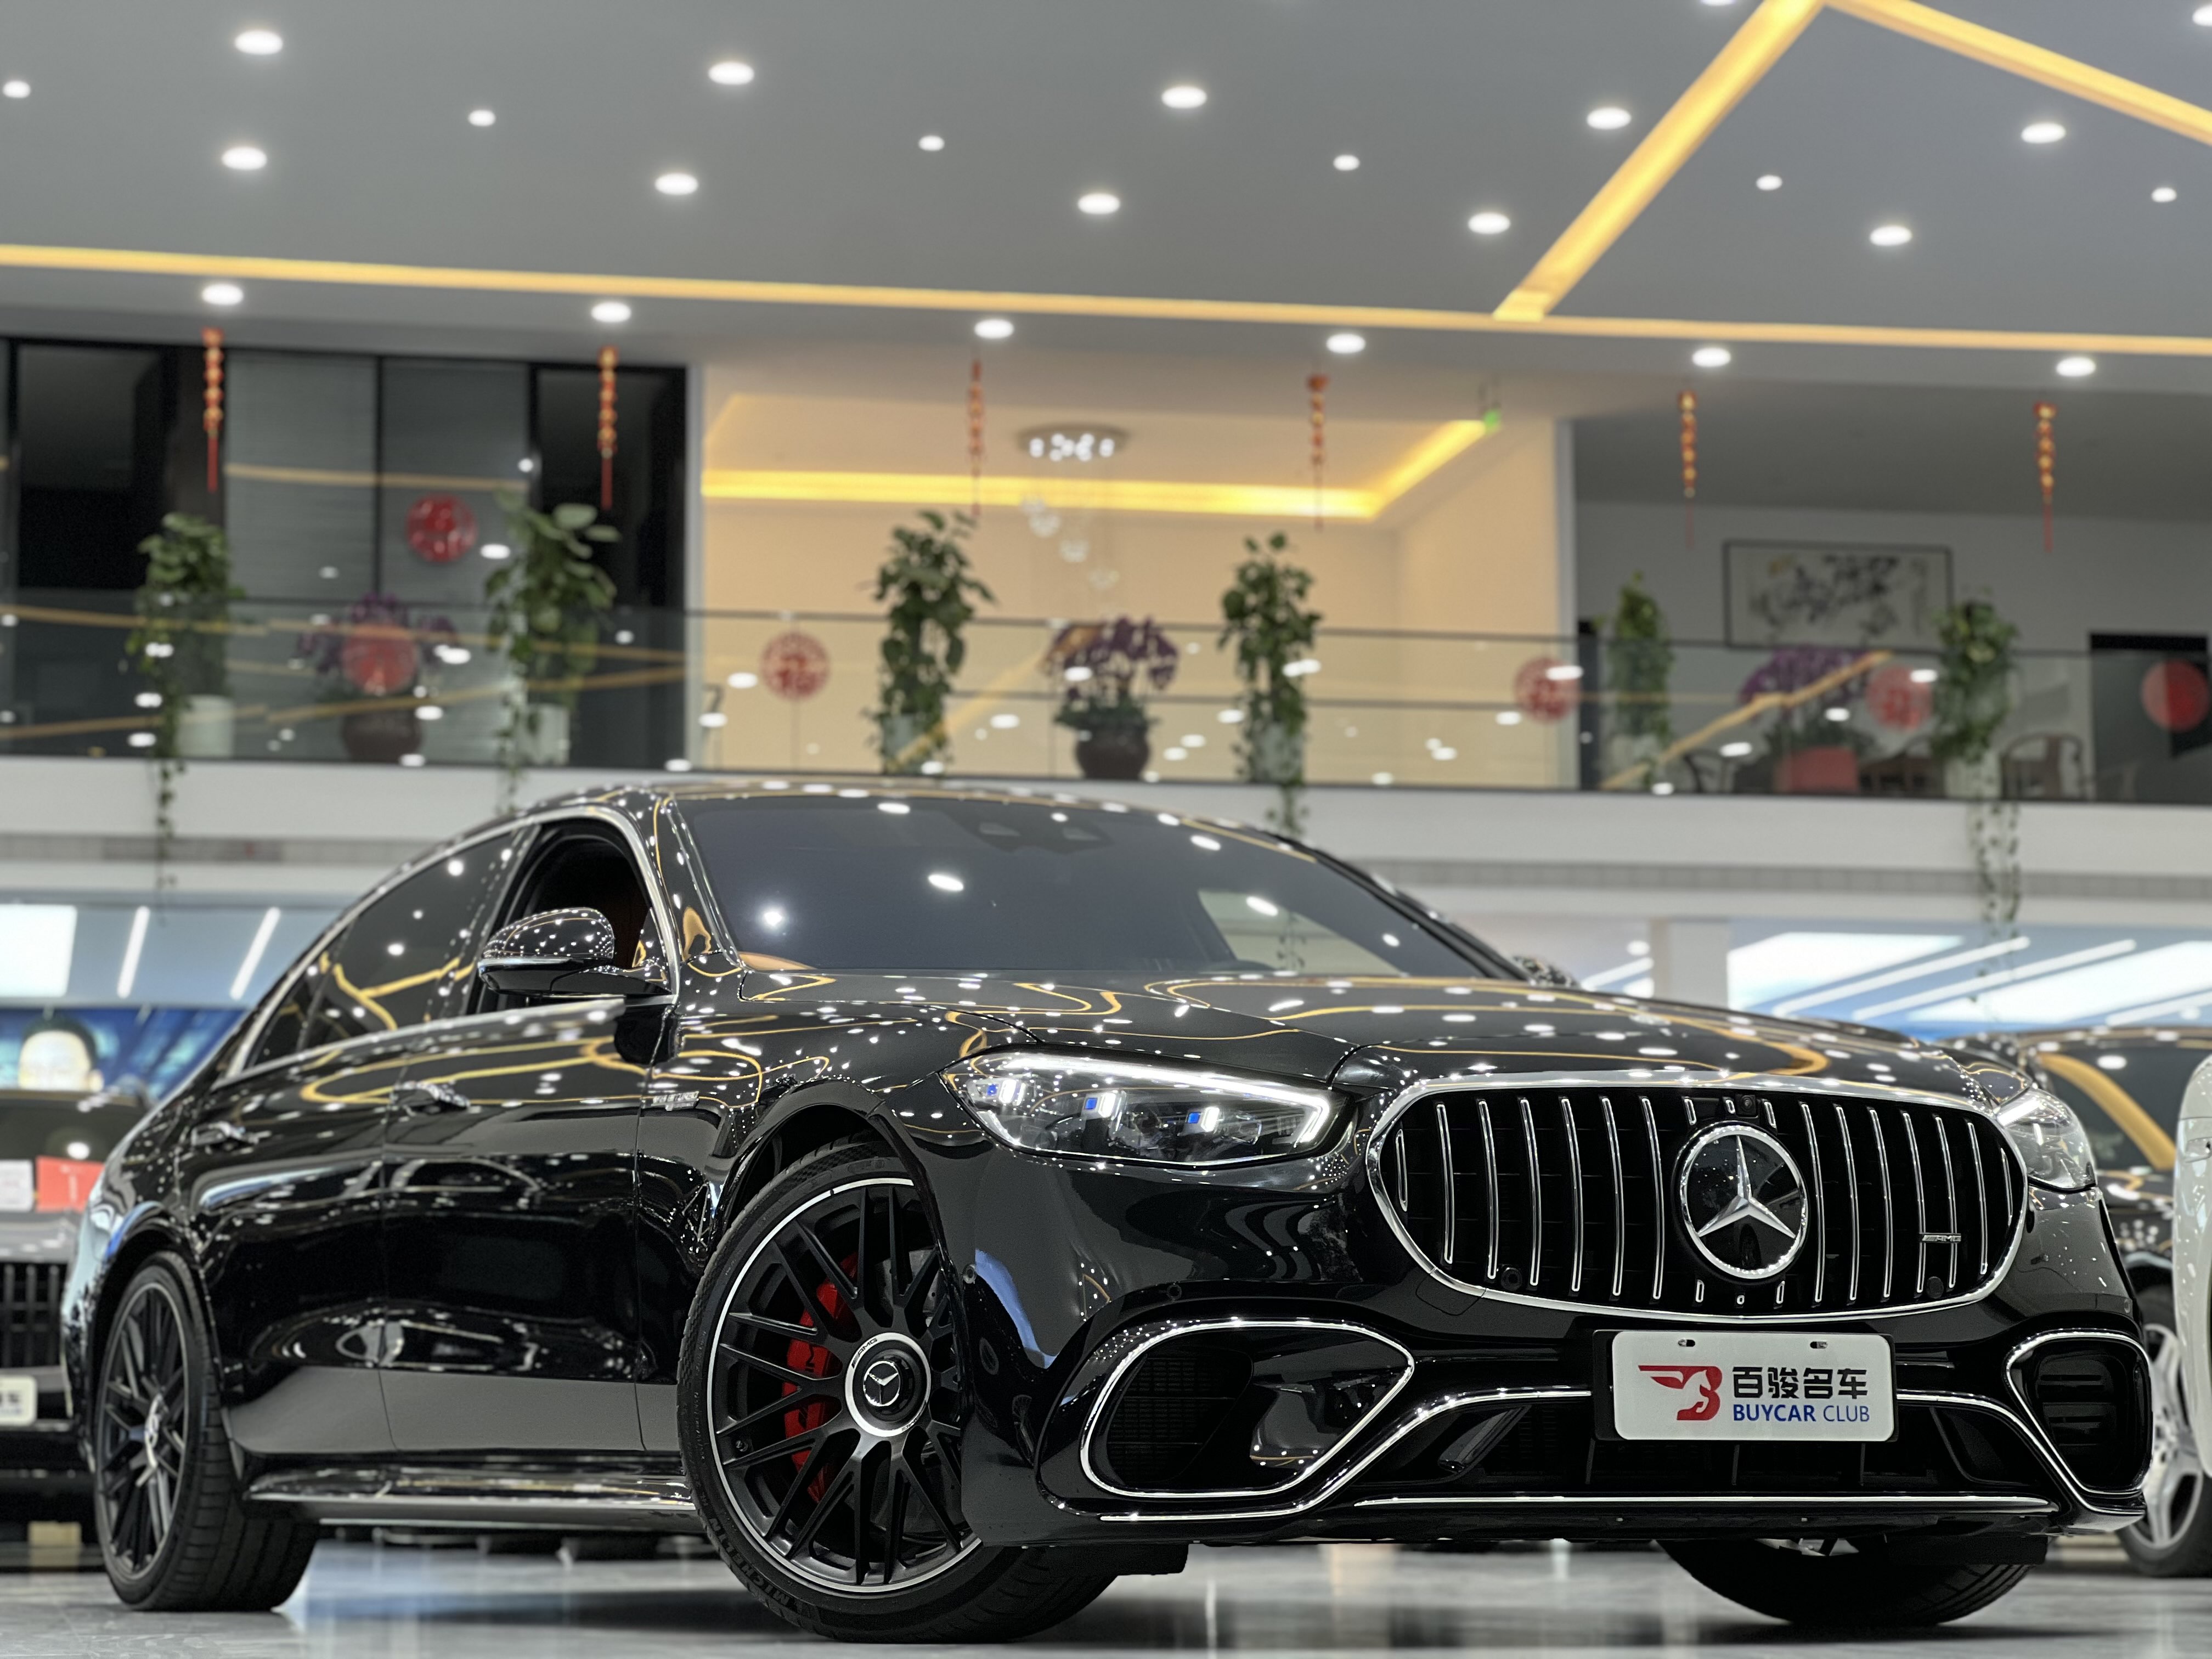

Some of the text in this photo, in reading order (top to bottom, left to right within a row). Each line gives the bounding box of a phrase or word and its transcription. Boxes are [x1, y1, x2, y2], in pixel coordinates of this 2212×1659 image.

[1732, 1366, 1868, 1400] 百骏名车
[1733, 1404, 1870, 1423] BUYCAR CLUB
